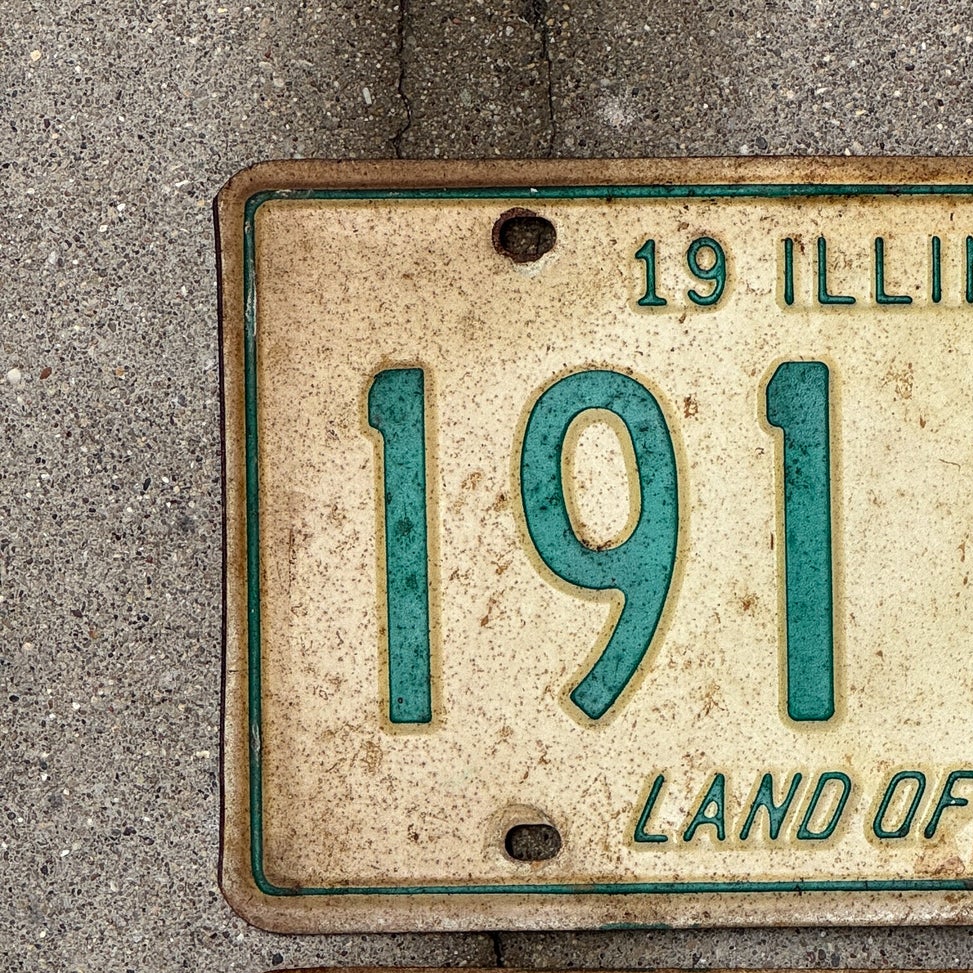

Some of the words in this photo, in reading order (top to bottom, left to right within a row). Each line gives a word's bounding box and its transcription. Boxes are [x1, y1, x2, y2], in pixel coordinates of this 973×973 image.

[636, 237, 727, 306] 19
[368, 361, 836, 724] 191
[635, 771, 852, 842] LAND
